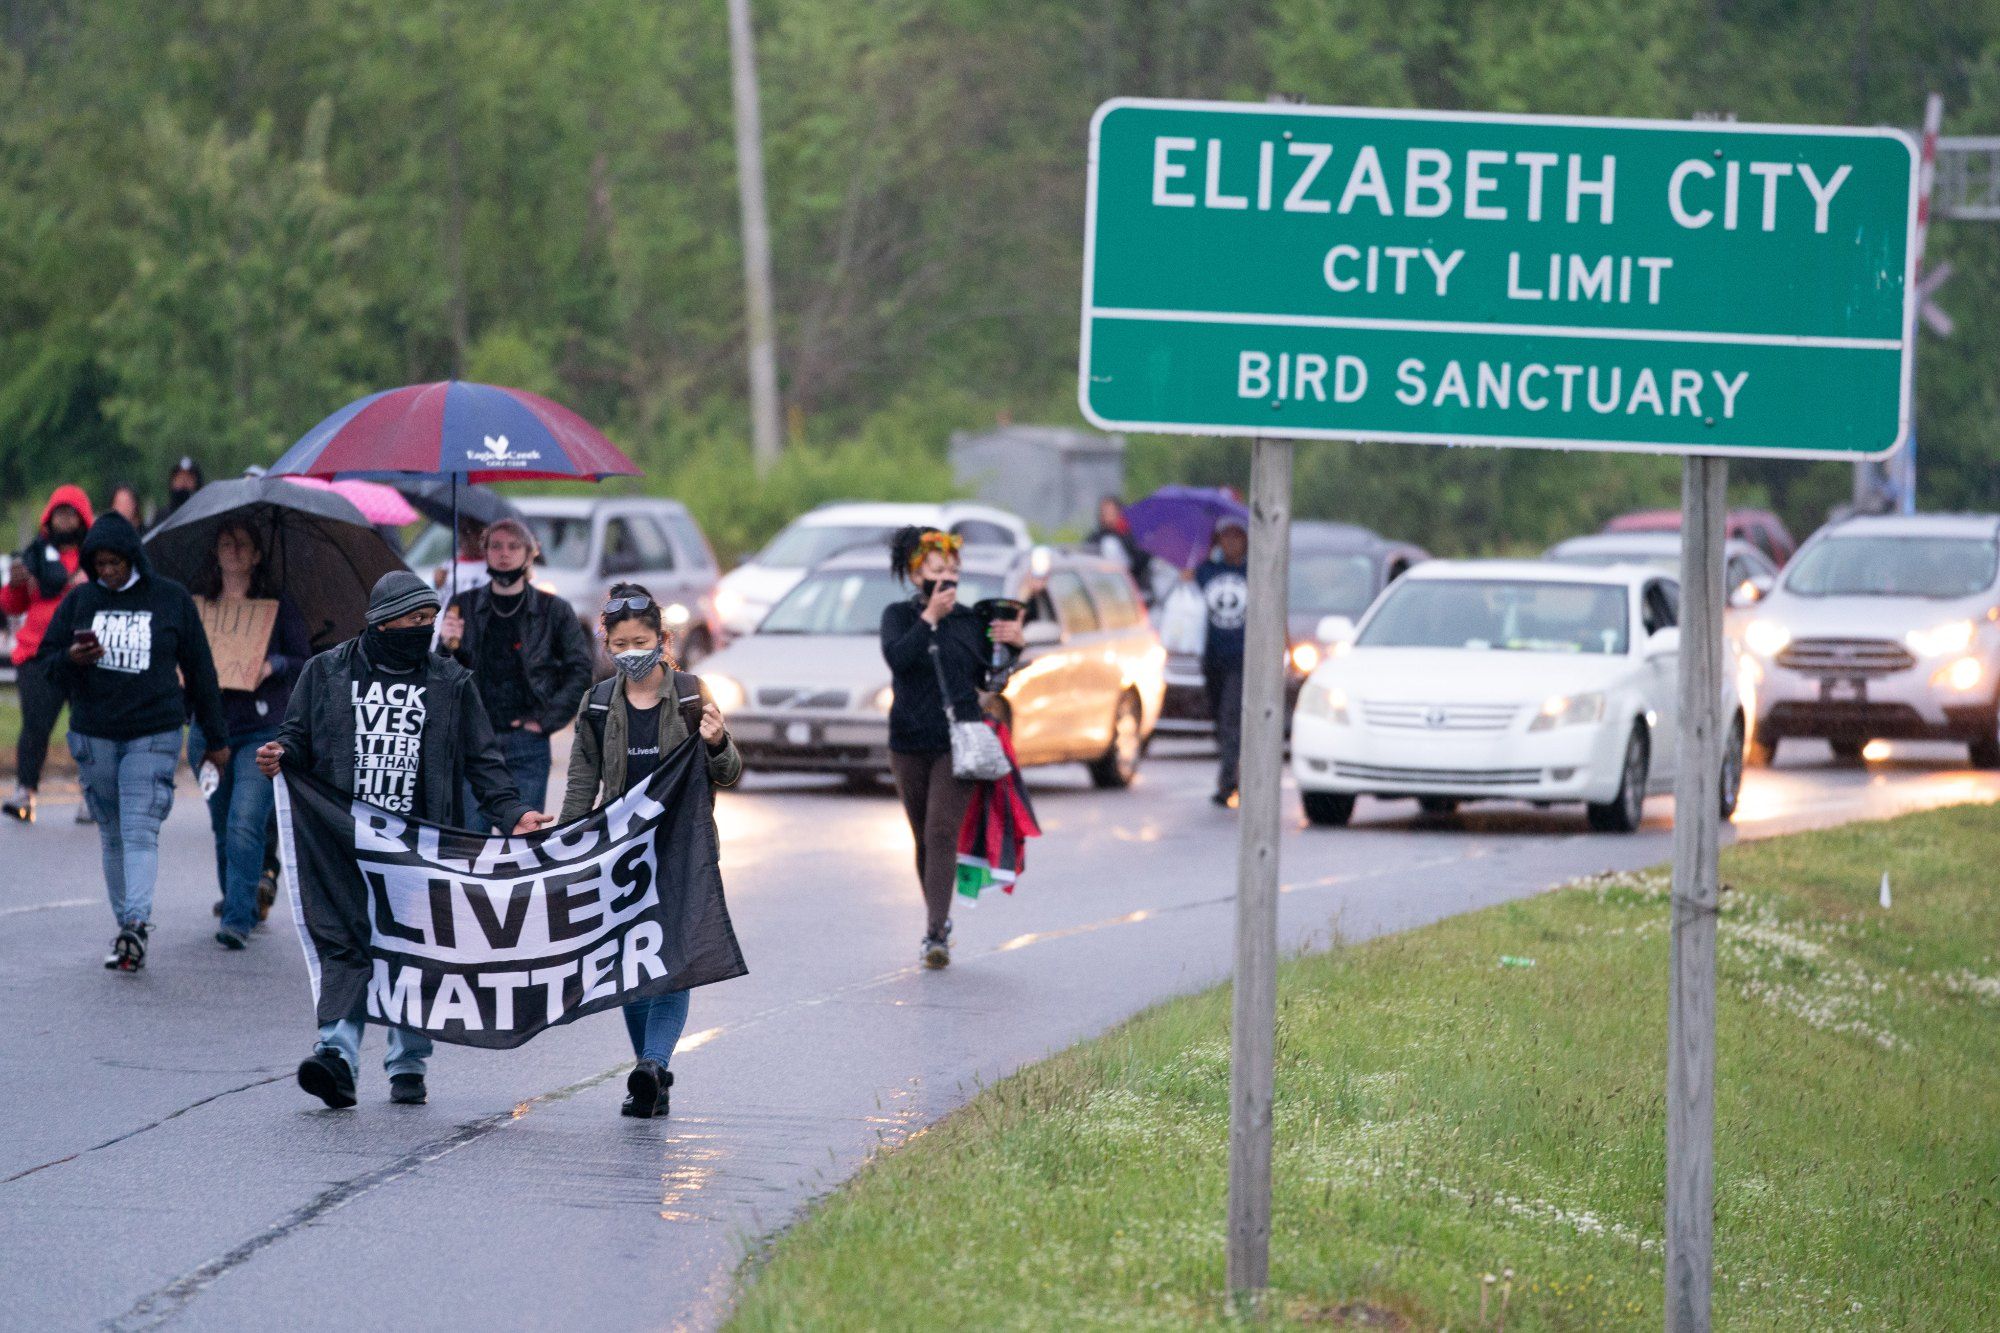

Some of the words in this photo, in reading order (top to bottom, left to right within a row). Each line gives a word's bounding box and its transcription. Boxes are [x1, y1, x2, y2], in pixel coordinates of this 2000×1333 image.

[1152, 136, 1616, 224] ELIZABETH
[1668, 158, 1853, 233] CITY
[1323, 244, 1466, 296] CITY
[1507, 252, 1673, 304] LIMIT
[1237, 351, 1368, 402] BIRD
[1395, 358, 1750, 418] SANCTUARY
[98, 647, 150, 670] ATTER
[351, 680, 427, 710] LACK
[354, 735, 421, 758] ATTER
[376, 756, 418, 771] THAN
[354, 769, 417, 796] HITE
[351, 773, 666, 874] BLACK
[364, 842, 652, 950] LIVES
[367, 920, 668, 1031] MATTER
